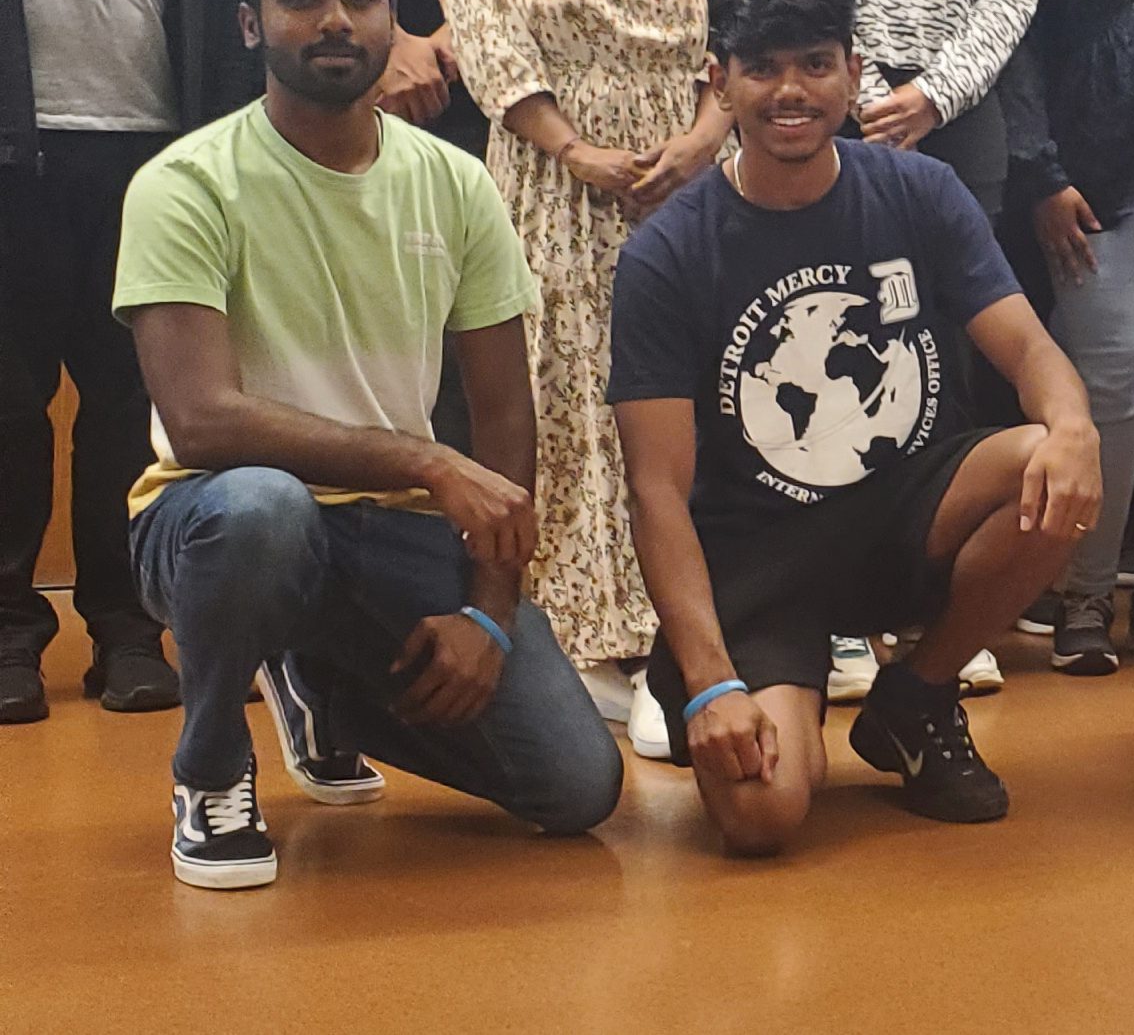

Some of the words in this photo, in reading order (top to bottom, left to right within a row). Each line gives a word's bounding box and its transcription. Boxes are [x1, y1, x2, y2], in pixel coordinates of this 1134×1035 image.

[718, 297, 768, 417] DETROIT
[763, 265, 852, 307] MERCY
[917, 328, 941, 394] OFFICE
